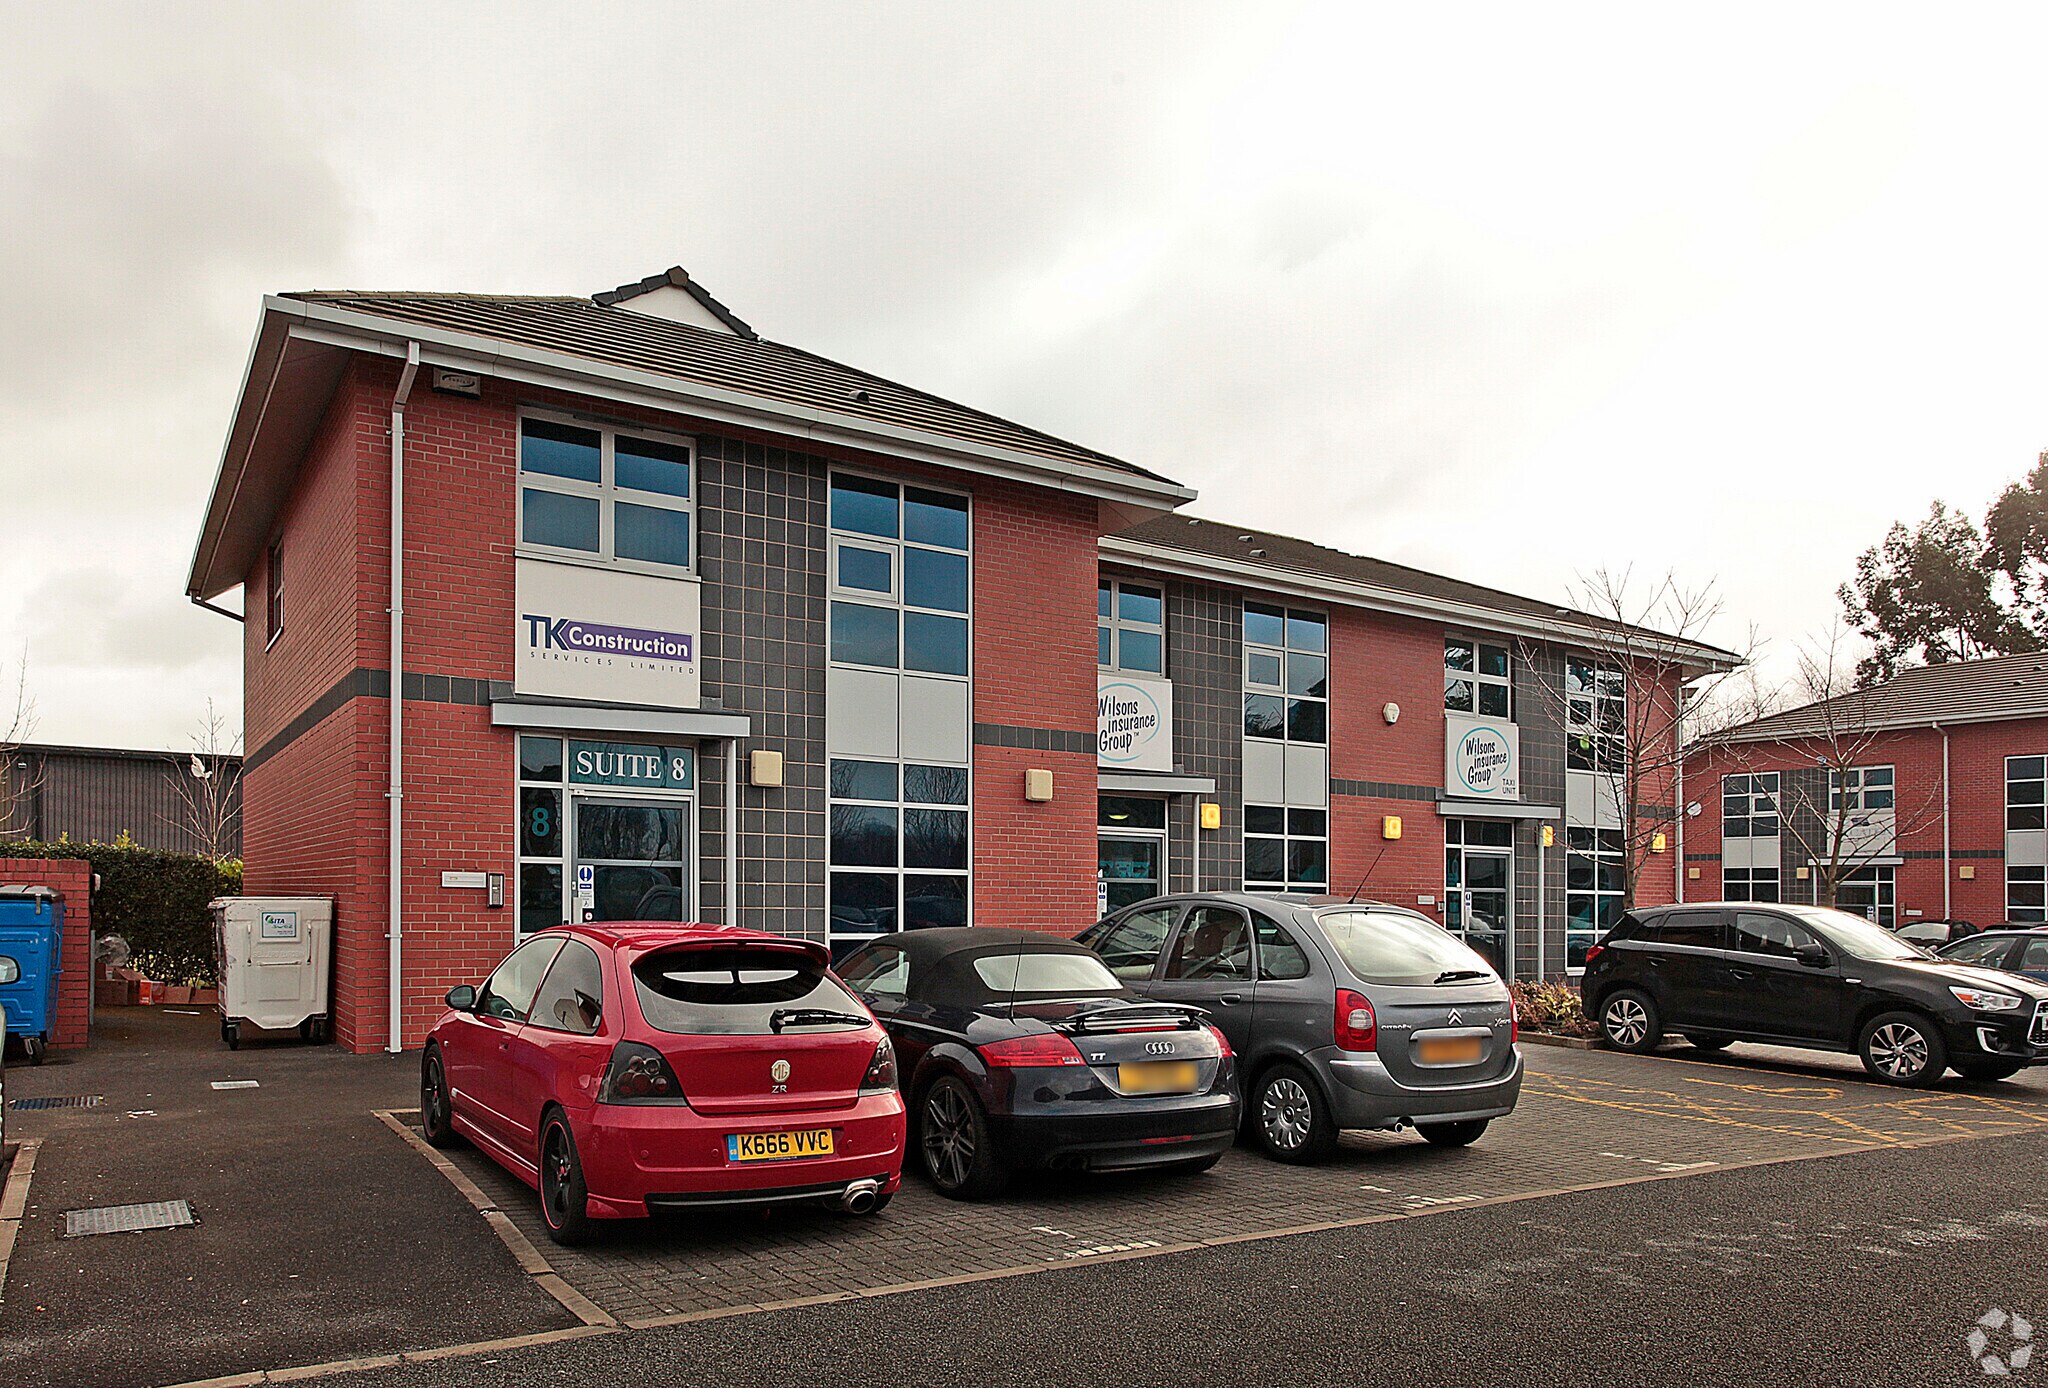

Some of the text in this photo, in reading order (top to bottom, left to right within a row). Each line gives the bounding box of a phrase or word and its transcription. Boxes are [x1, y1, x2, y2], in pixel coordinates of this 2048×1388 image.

[522, 614, 689, 657] TK Construction
[530, 651, 694, 675] SERVICES LIMITED
[1108, 713, 1156, 734] insurance
[1099, 729, 1133, 753] Group
[1466, 737, 1496, 756] Wilsons
[576, 750, 686, 781] SUITE 8
[1474, 752, 1507, 769] insurance
[1467, 765, 1492, 785] Group
[1502, 778, 1516, 787] TAXI
[1502, 786, 1516, 795] UNIT
[531, 807, 550, 837] 8
[1090, 1052, 1106, 1061] TT
[773, 1063, 790, 1081] MG
[771, 1084, 787, 1094] ZR
[741, 1131, 829, 1156] K666 VVC
